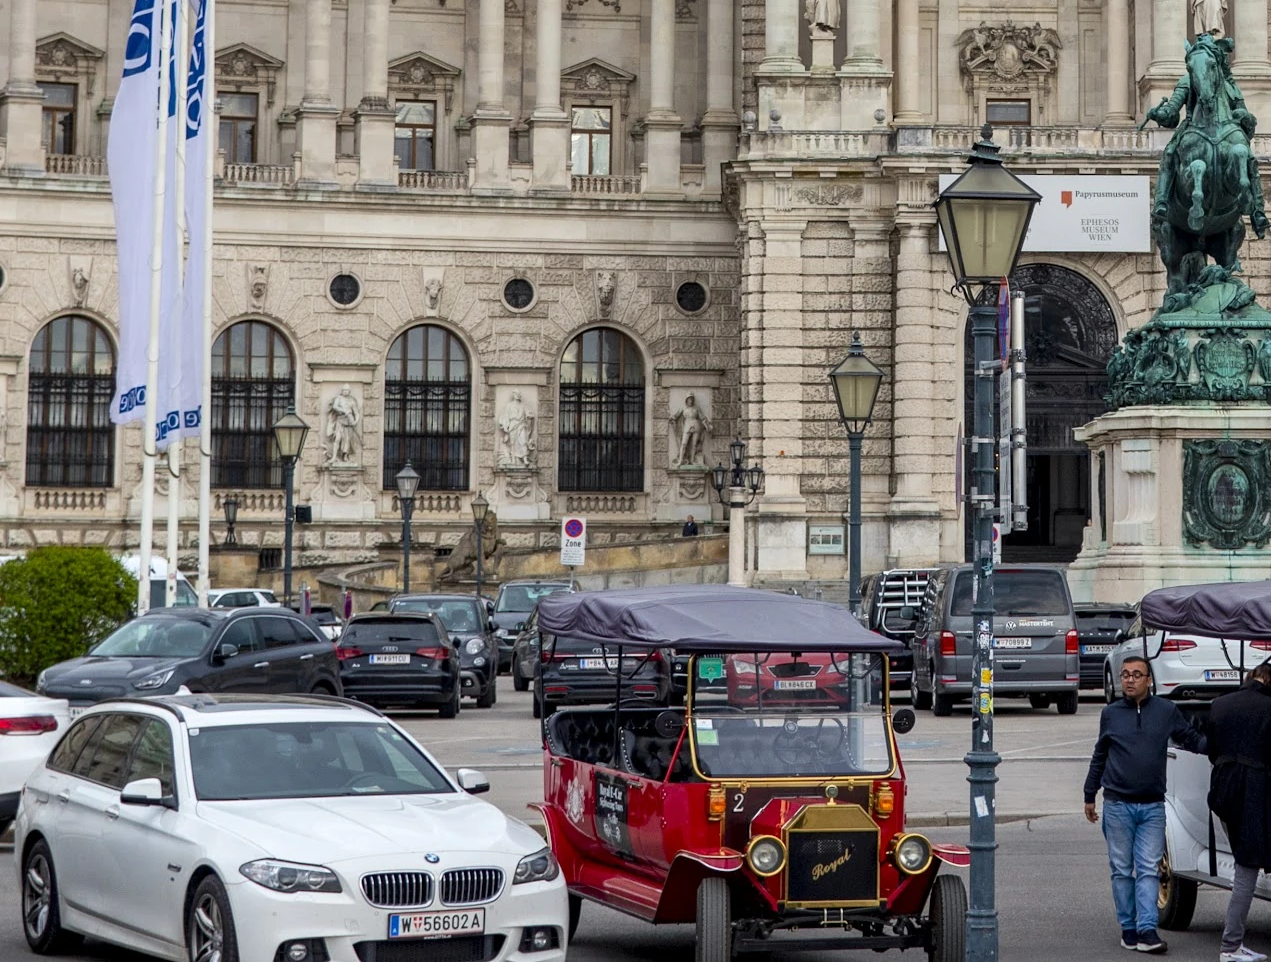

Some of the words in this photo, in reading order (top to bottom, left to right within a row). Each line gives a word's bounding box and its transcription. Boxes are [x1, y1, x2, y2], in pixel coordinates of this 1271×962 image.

[1075, 190, 1138, 199] Papyrusmuseum
[1081, 218, 1120, 226] EPHESOS
[1081, 226, 1119, 234] MUSEUM
[1088, 233, 1112, 241] WIEN
[565, 539, 582, 548] Zone
[733, 793, 745, 813] 2
[811, 848, 852, 880] Royal
[401, 917, 412, 933] W
